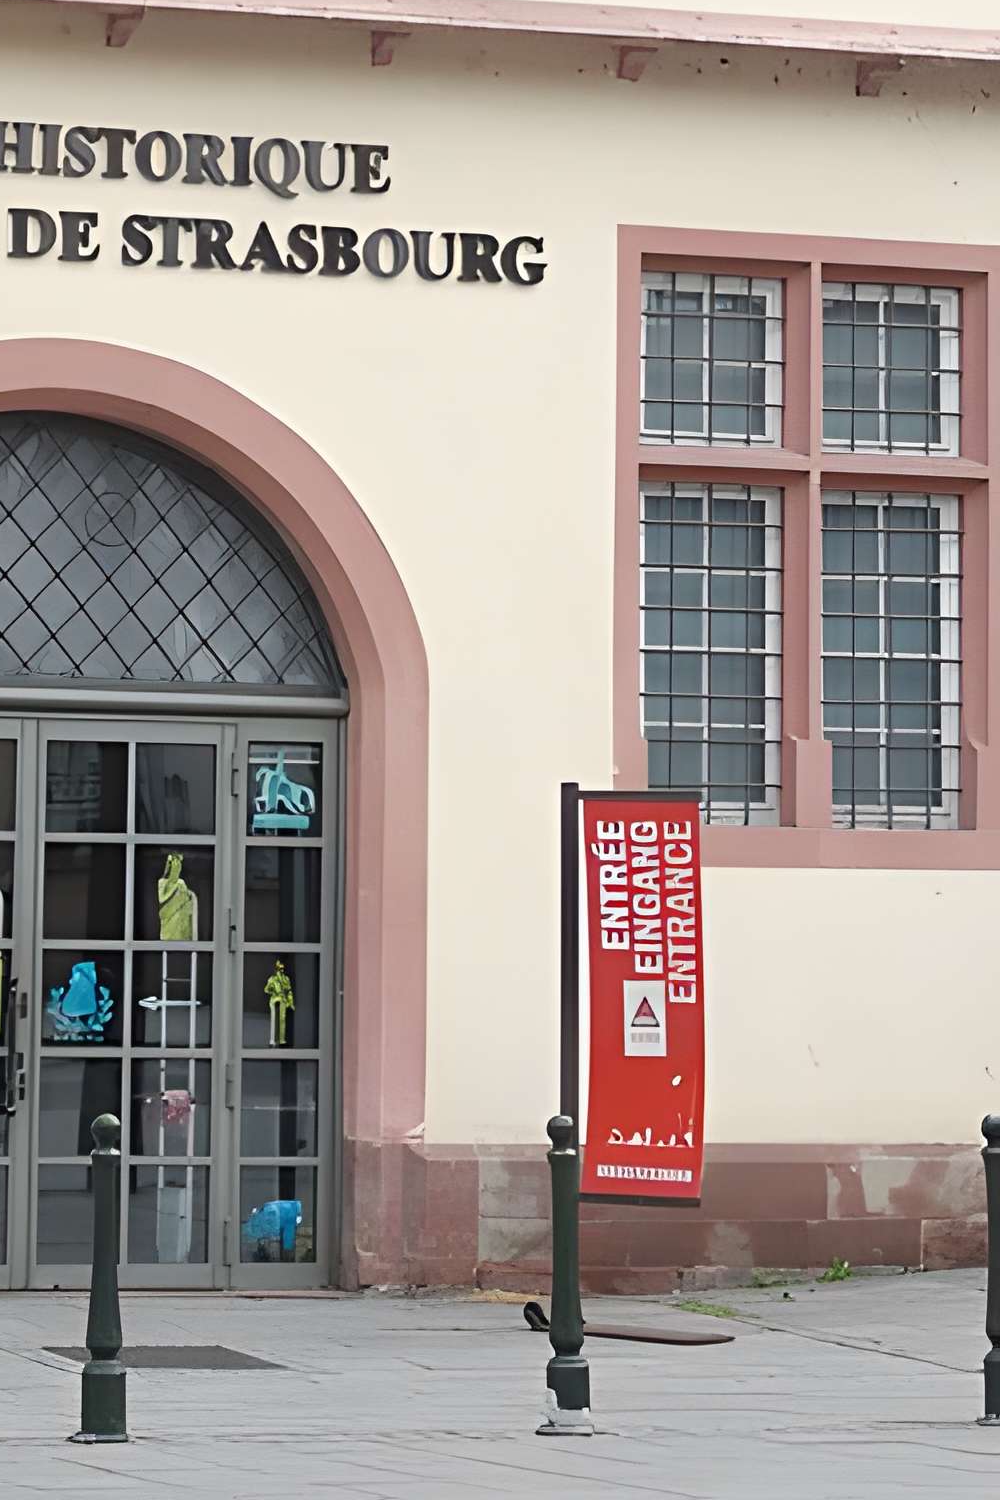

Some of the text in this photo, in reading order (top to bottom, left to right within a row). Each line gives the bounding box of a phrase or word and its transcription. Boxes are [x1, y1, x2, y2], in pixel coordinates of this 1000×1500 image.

[7, 207, 101, 262] DE
[121, 213, 548, 287] STRASBOURG
[591, 820, 630, 950] ENTRÉE
[630, 820, 664, 974] EINGANG
[663, 820, 697, 1004] ENTRANCE
